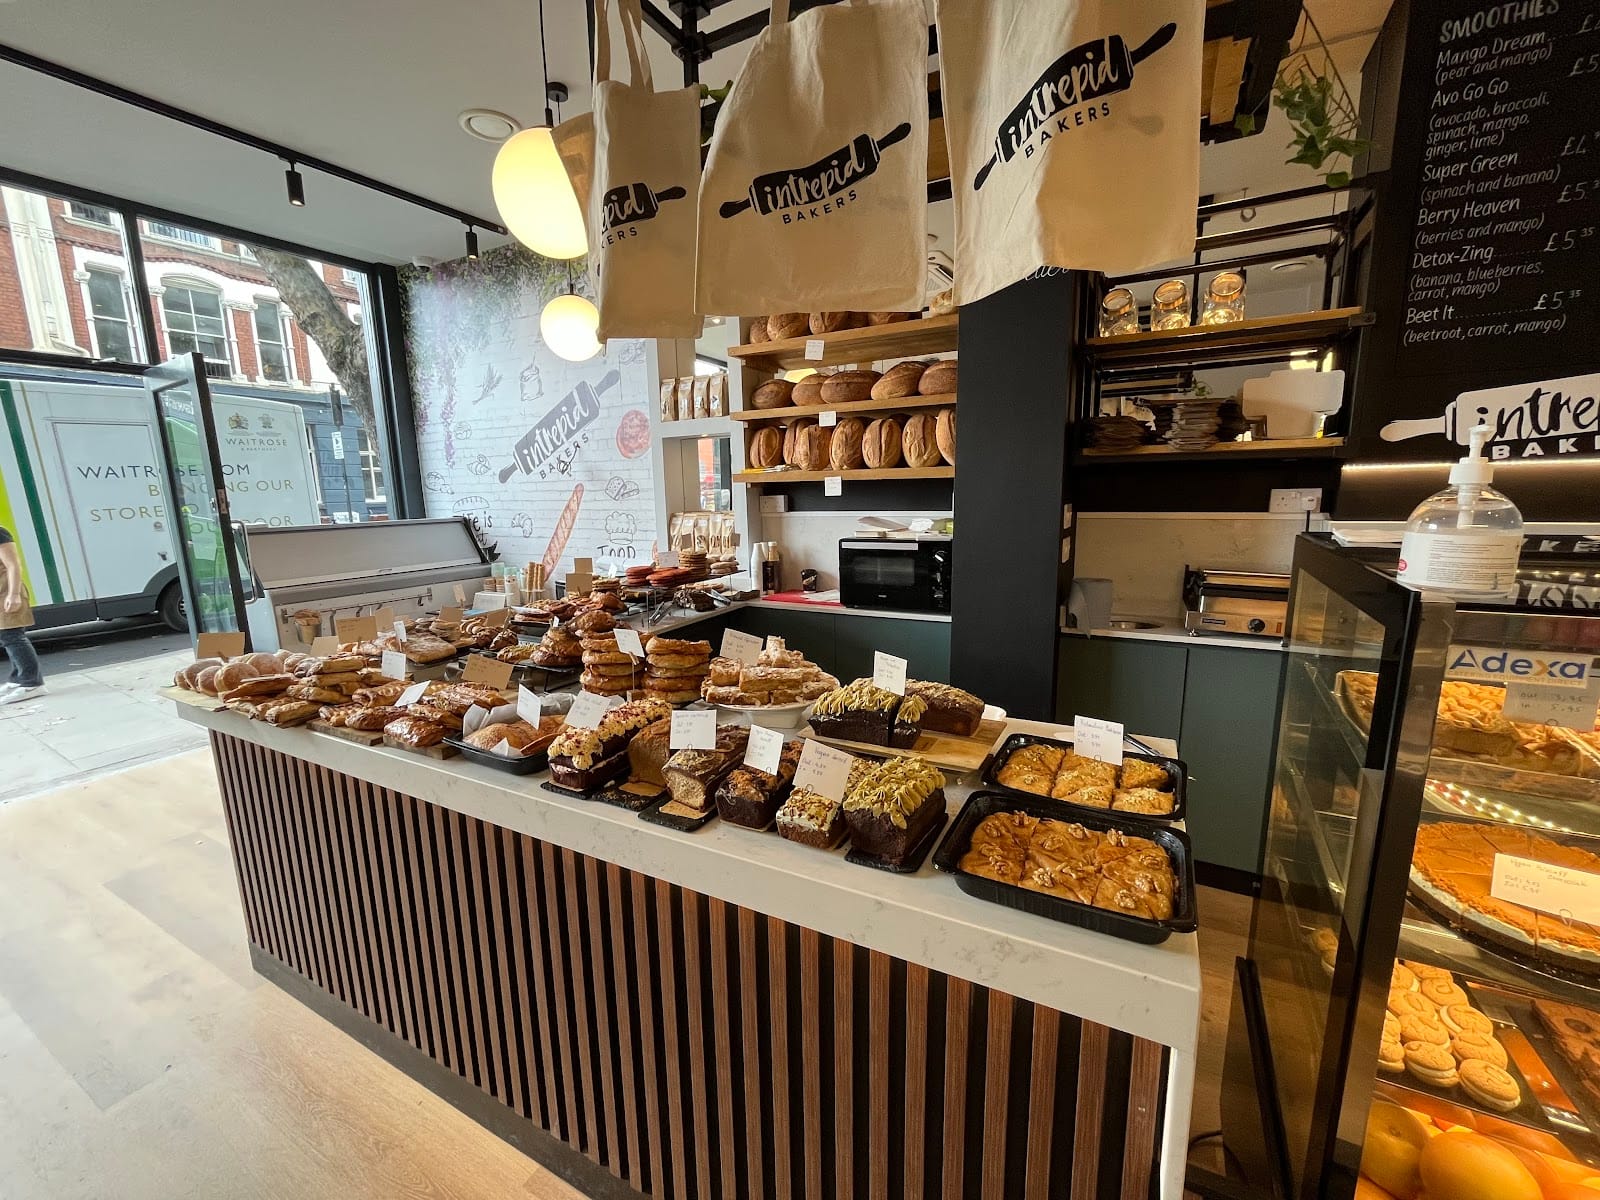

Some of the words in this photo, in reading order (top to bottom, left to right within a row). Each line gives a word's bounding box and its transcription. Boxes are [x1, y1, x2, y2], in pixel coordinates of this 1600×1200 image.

[1439, 0, 1560, 43] SMOOTHIES
[1435, 65, 1469, 86] (pear
[1473, 56, 1497, 75] and
[1500, 42, 1553, 68] mango)
[1436, 45, 1487, 69] Mango
[1493, 31, 1545, 54] Dream
[1008, 36, 1119, 148] intrepid
[1431, 91, 1459, 110] Avo
[1463, 83, 1483, 101] Go
[1488, 77, 1509, 96] Go
[1024, 102, 1110, 158] BAKERS
[1470, 130, 1505, 149] lime)
[763, 140, 866, 212] intrepid
[1421, 182, 1475, 206] (spinach
[1476, 178, 1500, 195] and
[1503, 165, 1561, 187] banana)
[1422, 162, 1469, 184] Super
[1470, 152, 1518, 174] Green
[782, 189, 857, 224] BAKERS
[1417, 206, 1460, 226] Berry
[1463, 198, 1520, 219] Heaven
[1415, 227, 1464, 249] (berries
[1467, 221, 1490, 238] and
[1493, 212, 1545, 235] mango)
[1412, 246, 1494, 269] Detox-Zing
[1452, 278, 1501, 299] mango)
[1406, 307, 1439, 325] Beet
[1442, 305, 1455, 320] It
[1513, 313, 1567, 333] mango)
[523, 391, 590, 472] intrepid
[1476, 388, 1600, 440] intre
[225, 438, 287, 447] WAITROSE
[539, 433, 590, 480] BAKERS
[256, 479, 294, 492] OUR
[1449, 649, 1587, 680] Adexa
